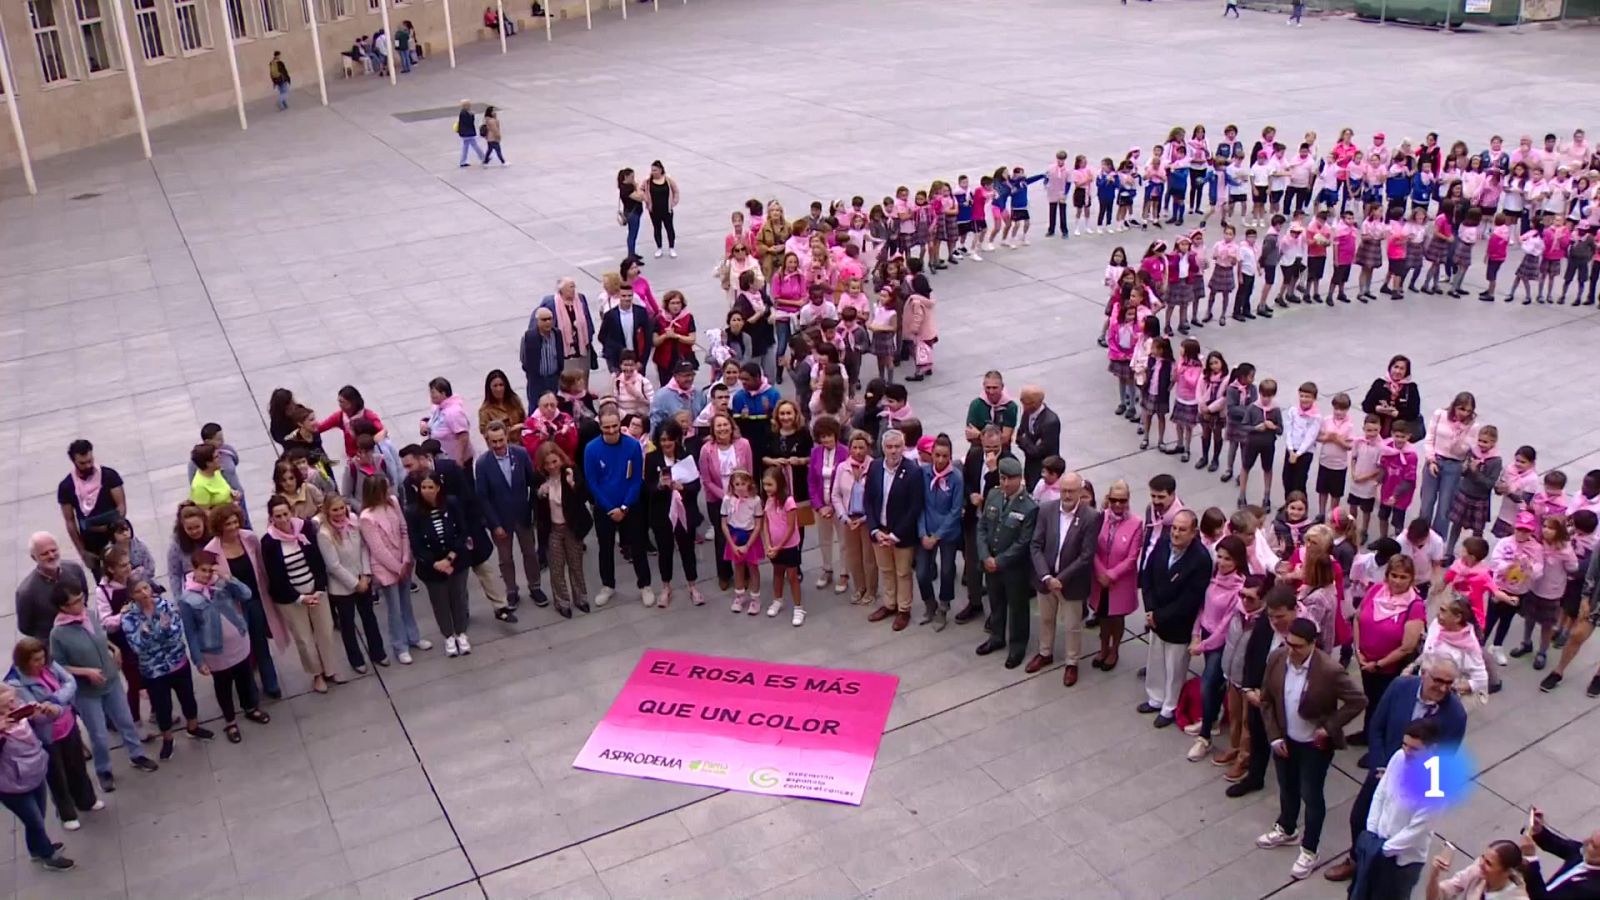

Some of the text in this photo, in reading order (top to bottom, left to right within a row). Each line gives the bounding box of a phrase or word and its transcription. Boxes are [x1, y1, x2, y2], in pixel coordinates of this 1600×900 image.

[649, 661, 861, 695] EL ROSA ES MÁS
[638, 699, 841, 735] QUE UN COLOR
[598, 748, 682, 770] ASPRODEMA
